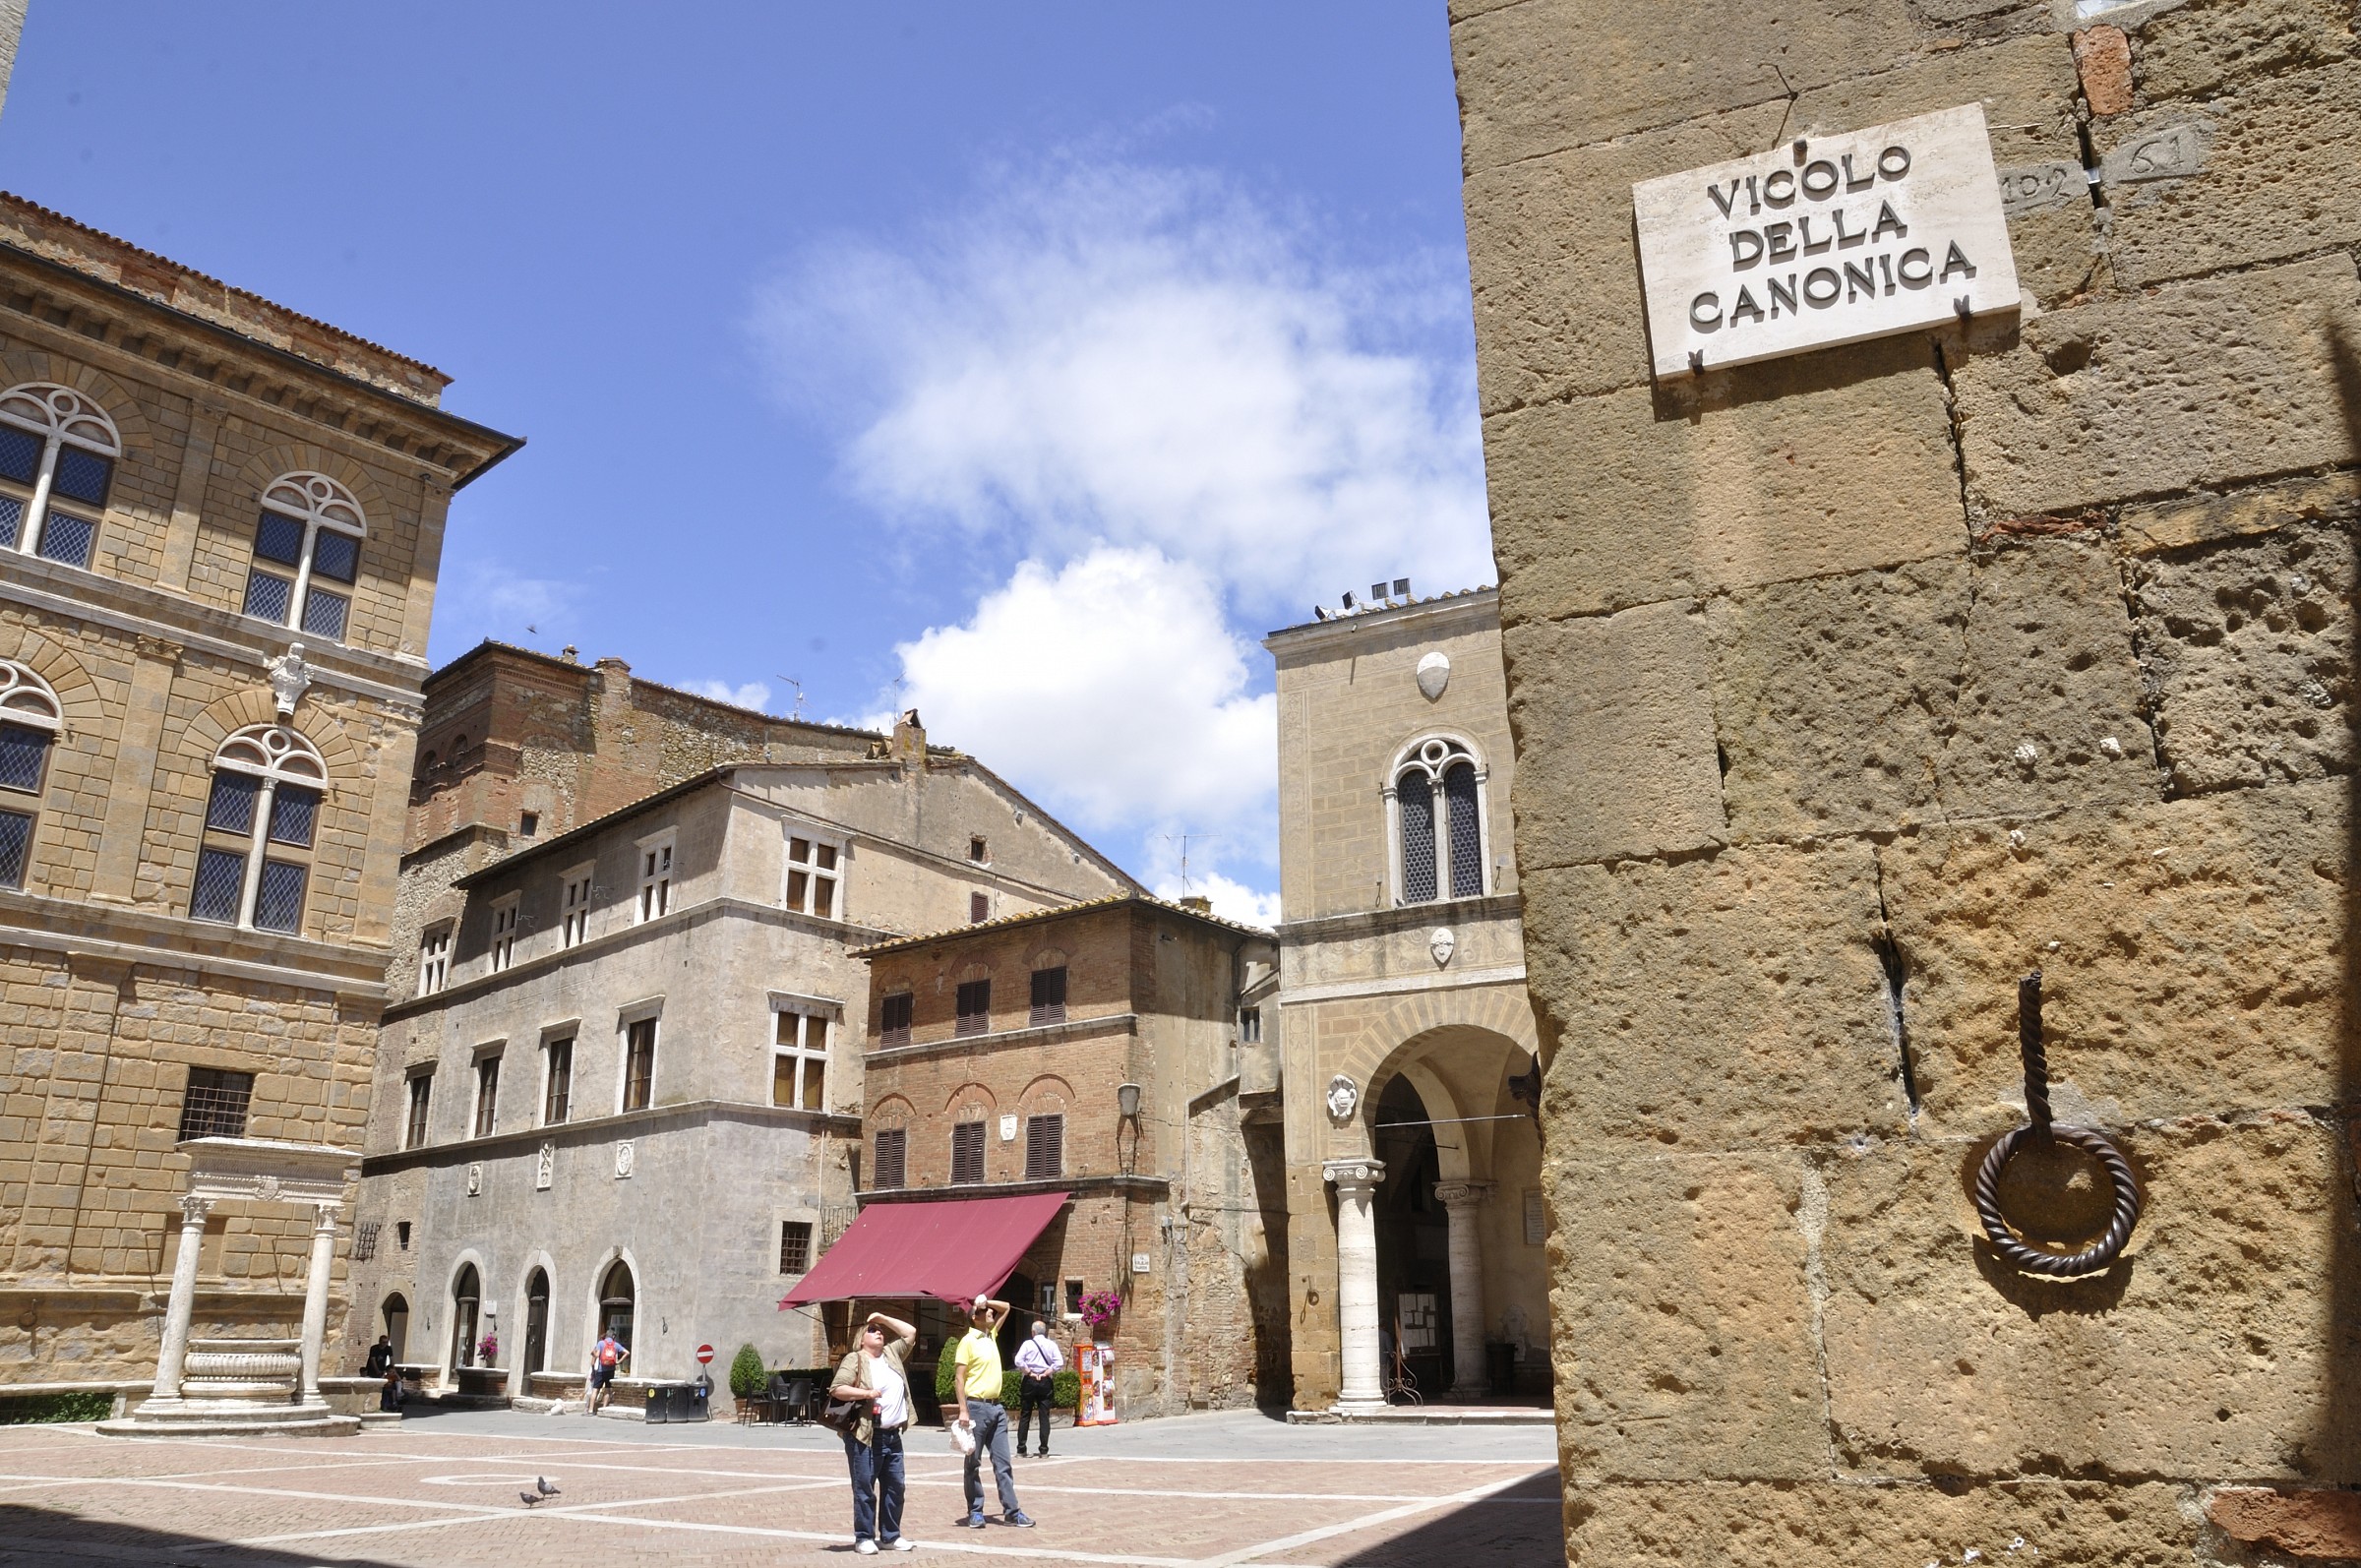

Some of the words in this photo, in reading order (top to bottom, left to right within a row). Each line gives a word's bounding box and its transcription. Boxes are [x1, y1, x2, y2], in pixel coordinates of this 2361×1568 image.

[1707, 146, 1911, 221] VICOLO
[2130, 136, 2184, 174] 61
[1729, 199, 1907, 272] DELLA
[1689, 239, 1977, 334] CANONICA
